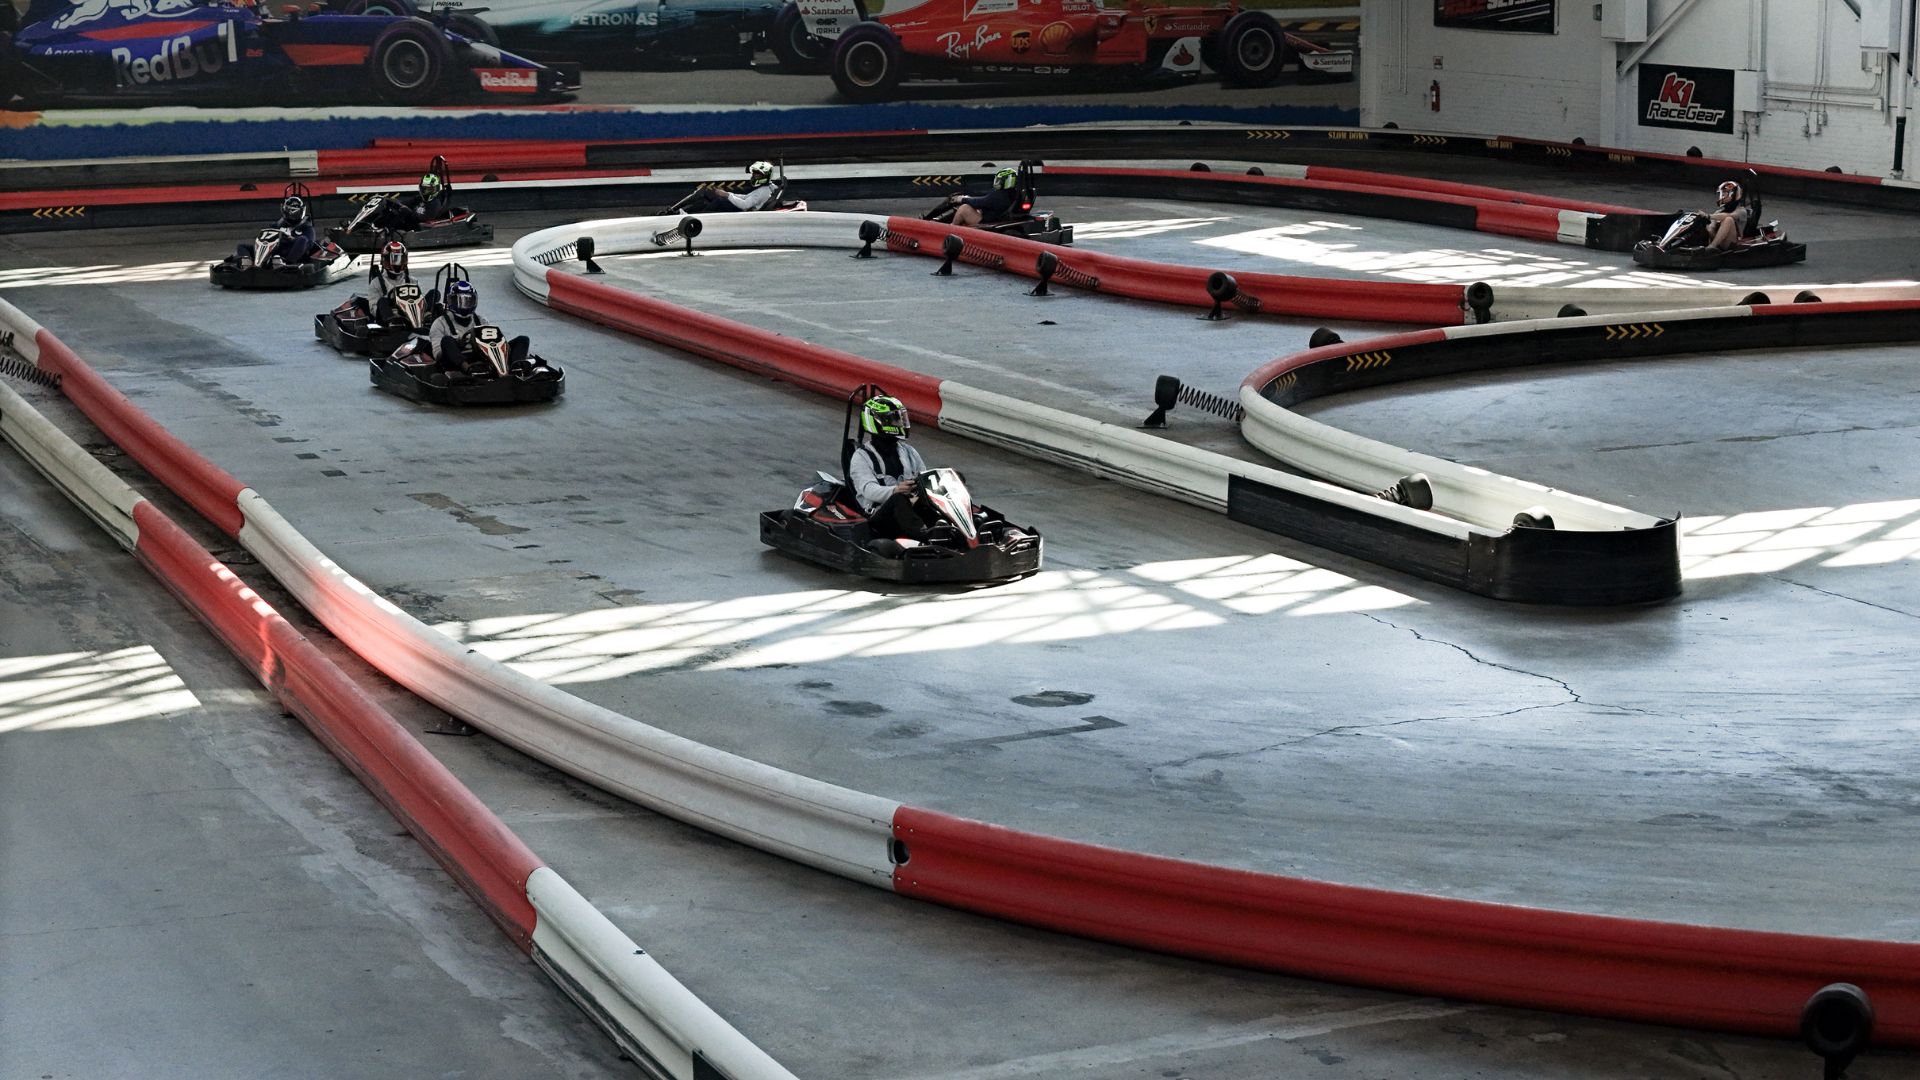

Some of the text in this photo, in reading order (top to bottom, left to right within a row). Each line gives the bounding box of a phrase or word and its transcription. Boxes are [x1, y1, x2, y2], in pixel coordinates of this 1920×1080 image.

[811, 6, 855, 15] Santander
[570, 12, 658, 26] PETRONAS
[1172, 22, 1210, 31] Santander
[936, 24, 1002, 59] Ray-Ban
[480, 71, 538, 87] RedBull
[1659, 73, 1695, 108] K1
[1647, 102, 1724, 124] RaceGear
[1328, 131, 1369, 140] SLOW DOWN
[260, 231, 279, 240] 17
[399, 286, 419, 297] 30
[481, 327, 498, 340] 8
